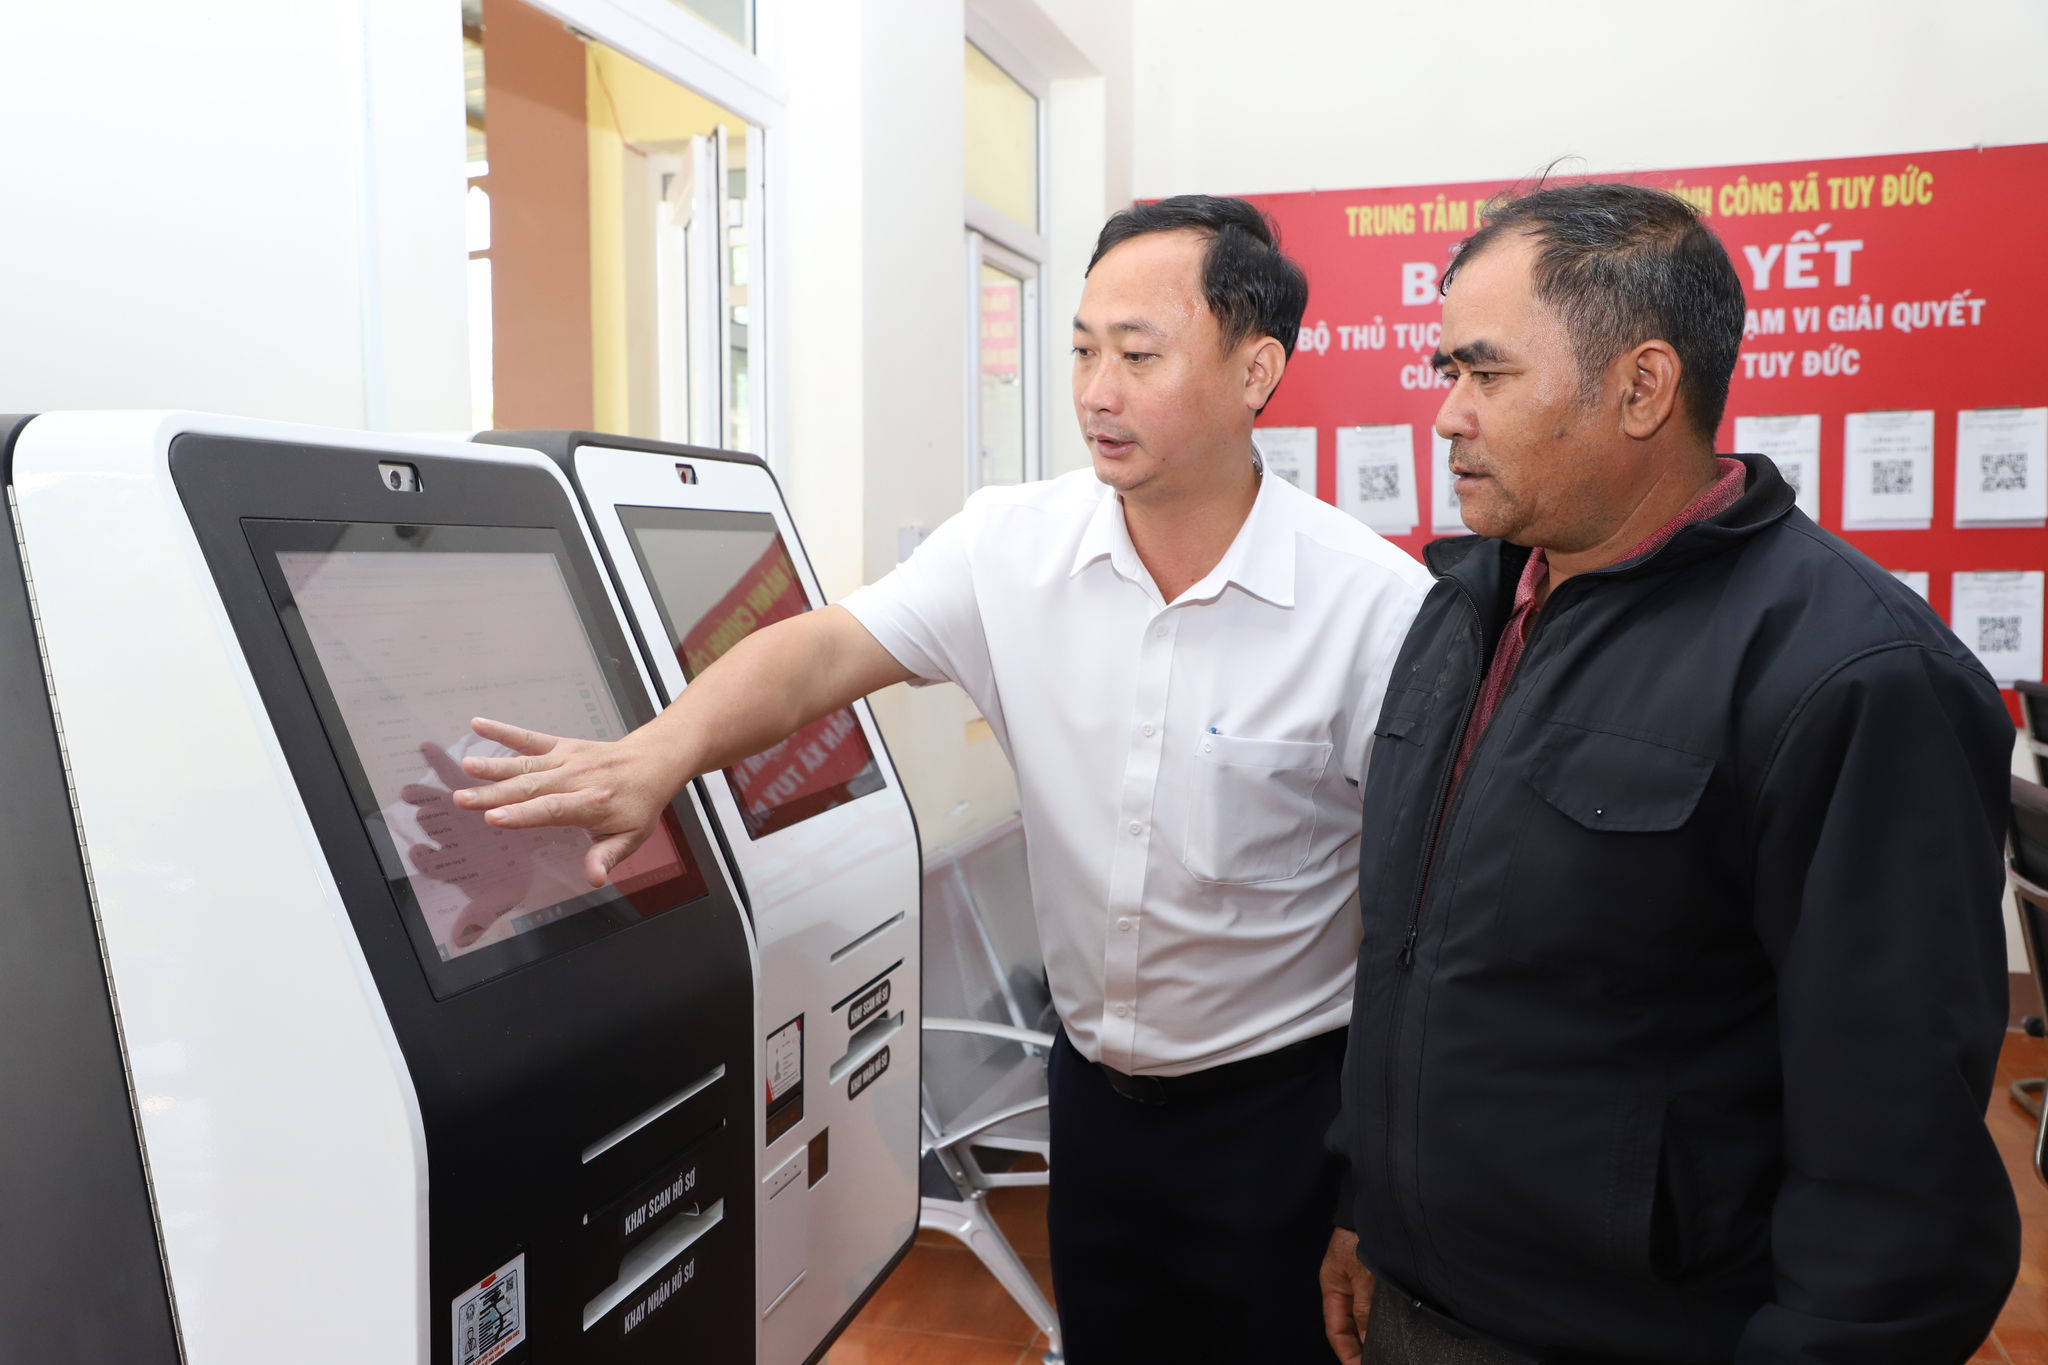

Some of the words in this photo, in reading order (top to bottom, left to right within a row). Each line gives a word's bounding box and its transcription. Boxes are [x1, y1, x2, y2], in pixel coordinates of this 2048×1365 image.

[1345, 203, 1416, 237] TRUNG
[1420, 193, 1468, 233] TÂM
[1667, 179, 1713, 217] ÍNH
[1719, 175, 1783, 217] CÔNG
[1788, 172, 1820, 213] XÃ
[1827, 175, 1875, 210] TUY
[1881, 164, 1934, 207] ĐỨC
[1743, 223, 1864, 291] YẾT
[1297, 320, 1330, 356] BỘ
[1336, 315, 1386, 351] THỦ
[1393, 322, 1442, 353] TỤC
[1743, 307, 1787, 341] ẠM
[1793, 307, 1821, 333] VI
[1827, 294, 1884, 332] GIẢI
[1891, 289, 1986, 333] QUYẾT
[1742, 351, 1795, 379] TUY
[1802, 342, 1861, 378] ĐỨC
[625, 1203, 647, 1236] KHAY
[648, 1186, 671, 1218] SCAN
[672, 1171, 684, 1201] HỒ
[684, 1166, 696, 1192] SƠ
[624, 1300, 646, 1335] KHAY
[647, 1280, 670, 1315] NHẬN
[671, 1264, 683, 1294] HỒ
[683, 1257, 695, 1283] SƠ
